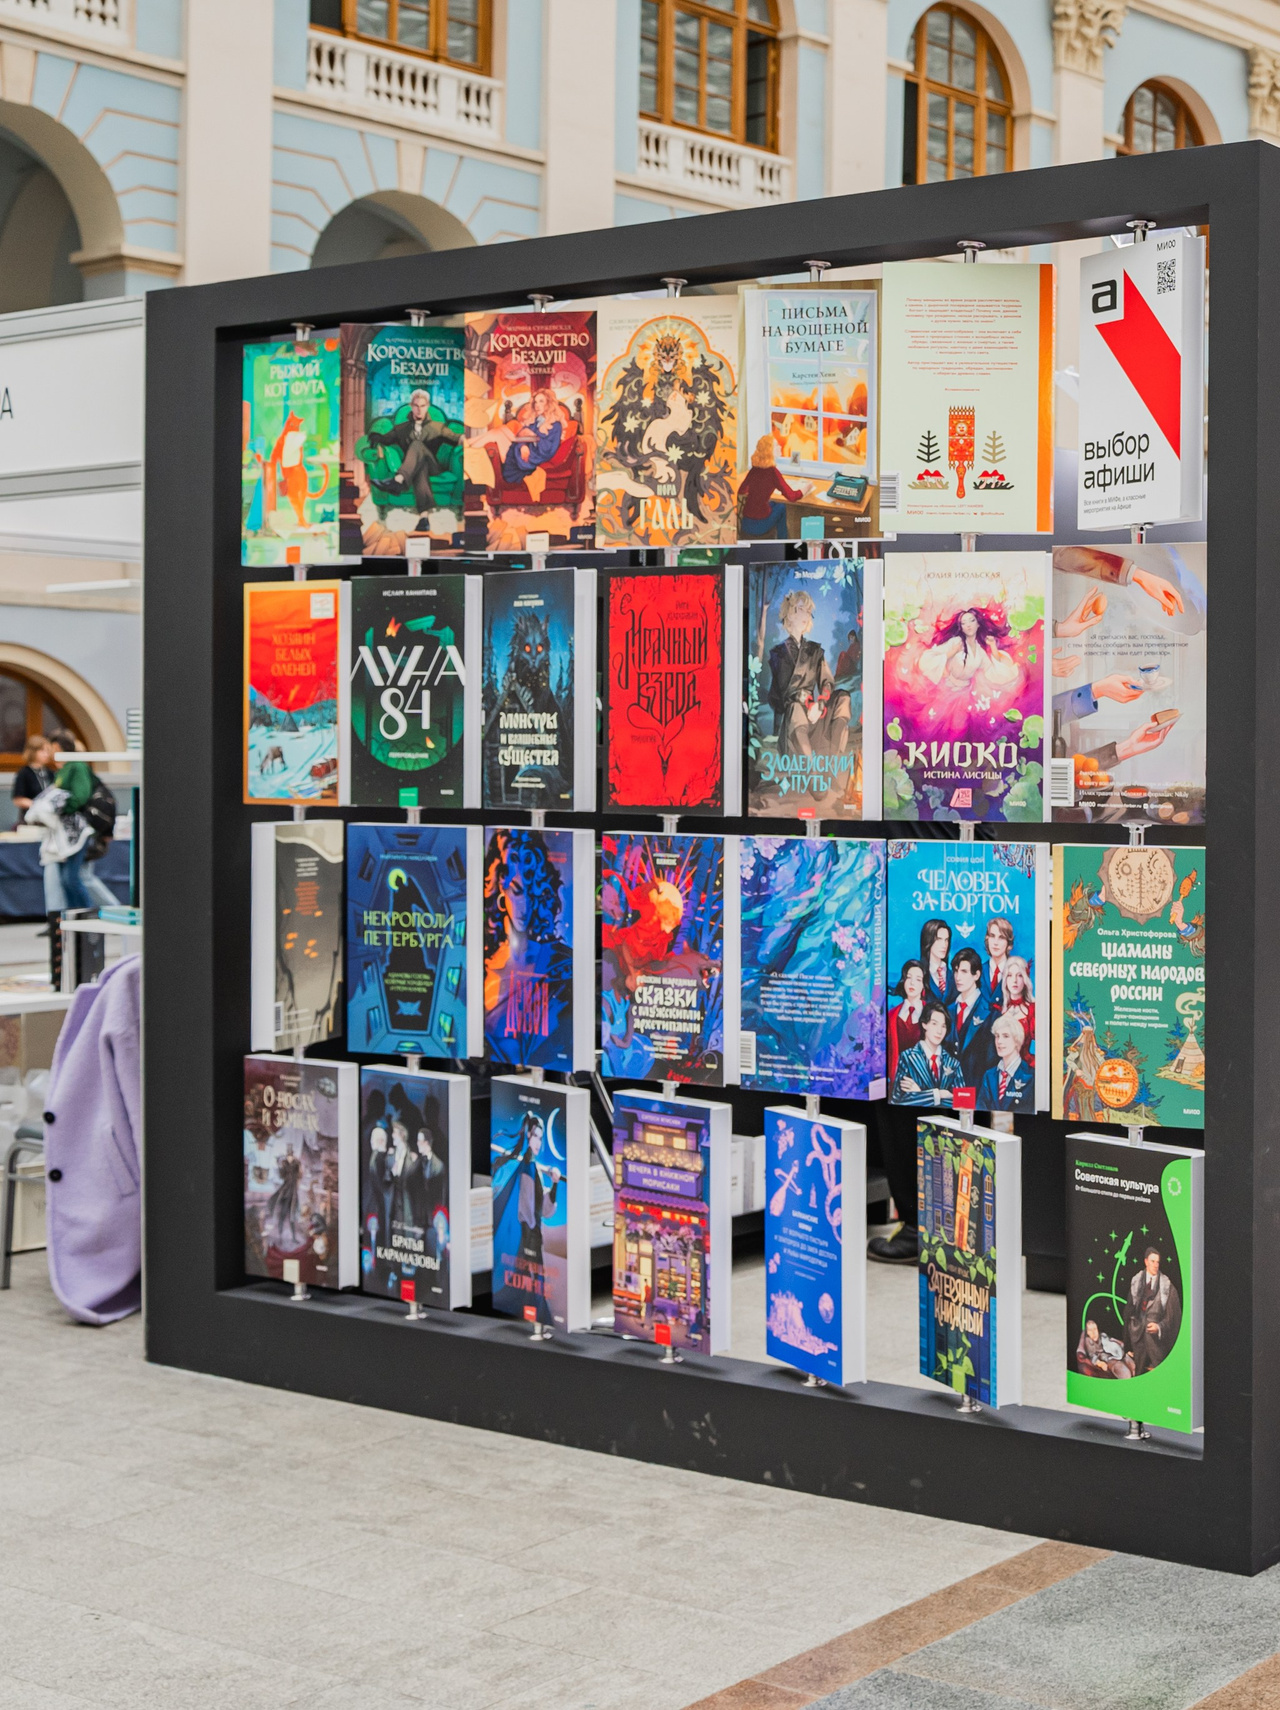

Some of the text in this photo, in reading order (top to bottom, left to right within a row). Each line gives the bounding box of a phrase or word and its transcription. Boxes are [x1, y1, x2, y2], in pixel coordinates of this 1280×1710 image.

[781, 305, 849, 321] ПИСЬМА
[761, 318, 869, 339] НА ВОЩЕНОЙ
[490, 332, 590, 352] КОРОЛЕВСТВО
[784, 339, 846, 355] БУМАГЕ
[390, 358, 450, 377] БЕЗДУШ
[511, 349, 567, 366] БЕЗДУШ
[270, 358, 320, 380] РЫЖИЙ
[264, 378, 327, 398] КОТ ФУТА
[1084, 430, 1150, 461] выбор
[1083, 461, 1155, 493] афиши
[656, 484, 677, 496] НОРА
[639, 497, 694, 531] ГАЛЬ
[926, 570, 1001, 579] ЮЛИЯ ИЮЛЬСКАЯ
[271, 632, 316, 645] ХОЗЯИН
[275, 647, 312, 662] БЕЛЫХ
[270, 661, 316, 677] ОЛЕНЕЙ
[351, 645, 466, 687] ЛУНА
[379, 679, 432, 741] 84
[637, 671, 701, 728] ВЗВОД
[499, 711, 558, 734] МОНСТРЫ
[498, 745, 559, 769] СУЩЕСТВА
[904, 740, 1019, 769] КИОКО
[760, 750, 855, 781] ЗЛОДЕЙСКИЙ
[923, 769, 1003, 781] ИСТИНА ЛИСИЦЫ
[946, 856, 985, 865] СОФИЯ ЦОЙ
[873, 868, 883, 901] САД
[917, 868, 1010, 894] ЧЕЛОВЕК
[911, 891, 1020, 915] ЗА БОРТОМ
[363, 910, 455, 930] НЕКРОПОЛИ
[363, 930, 455, 950] ПЕТЕРБУРГА
[1097, 928, 1177, 939] Ольга Христофорова
[873, 903, 883, 987] ВИШНЕВЫЙ
[1113, 1005, 1142, 1013] Железные
[628, 1163, 652, 1175] ВЕЧЕРА
[1074, 1168, 1160, 1196] Советская культура
[391, 1233, 425, 1253] БРАТЬЯ
[376, 1245, 441, 1272] КАРАМАЗОВЫ
[926, 1261, 989, 1314] ЗАТЕРЯННЫЙ
[934, 1294, 984, 1338] КНИЖНЫЙ
